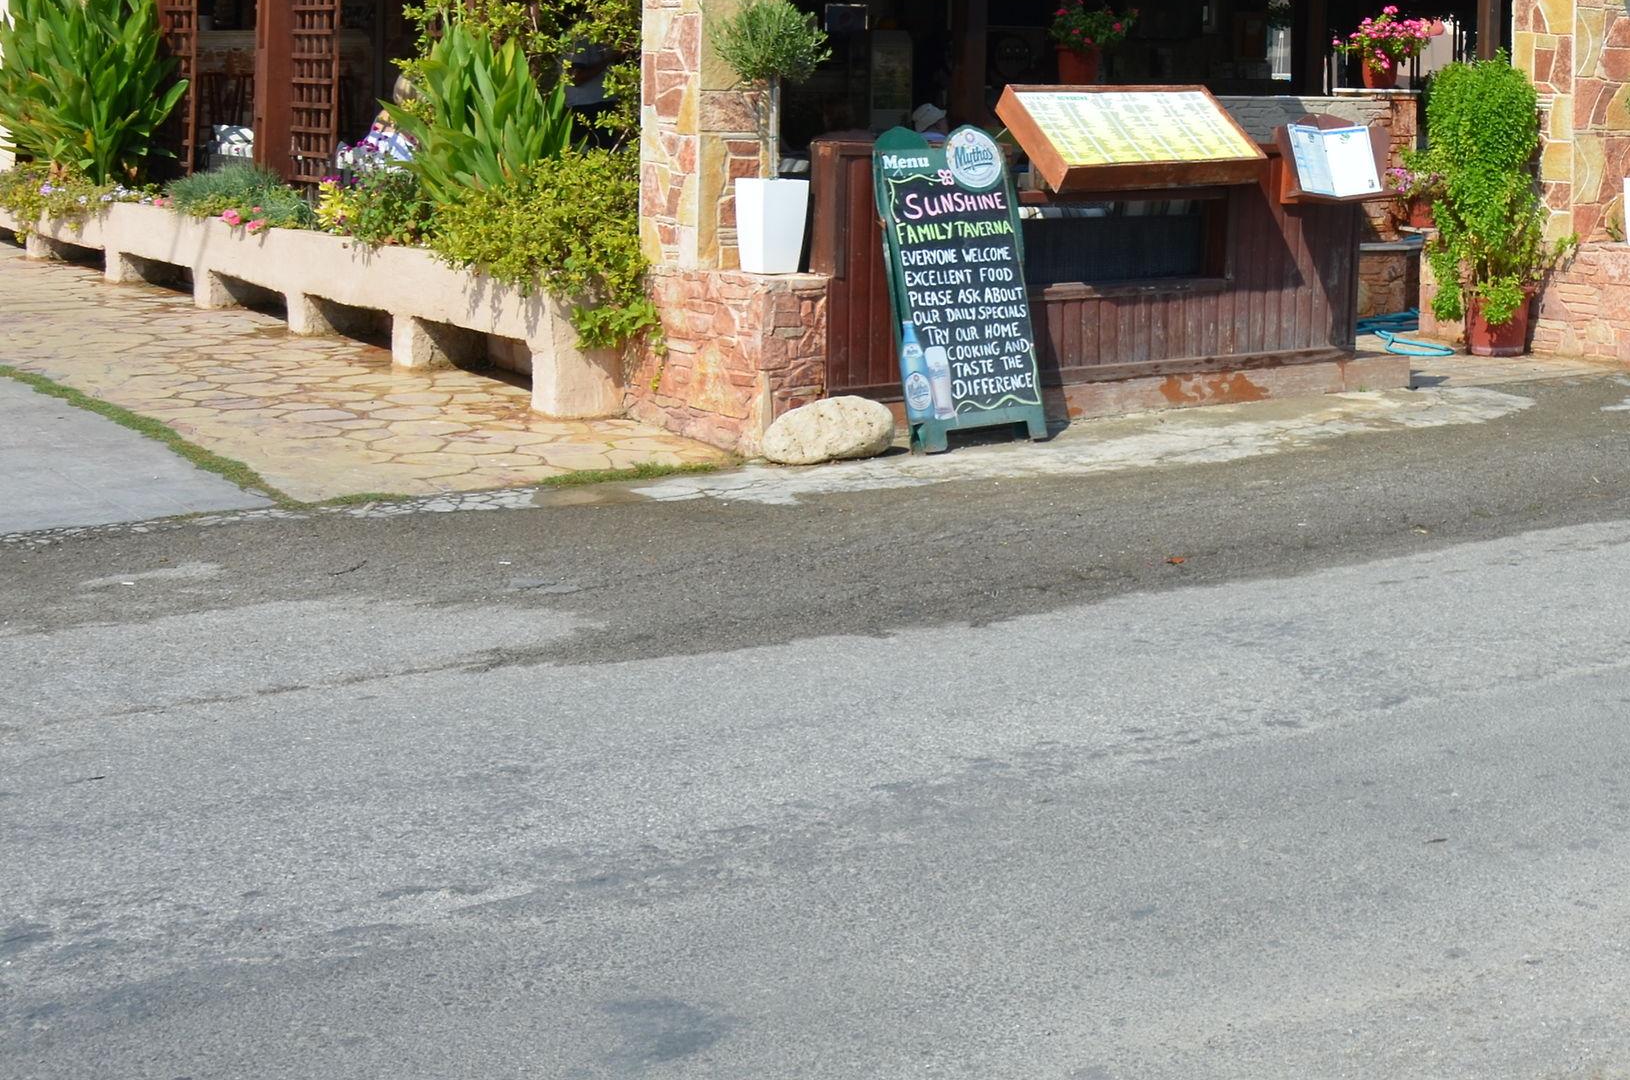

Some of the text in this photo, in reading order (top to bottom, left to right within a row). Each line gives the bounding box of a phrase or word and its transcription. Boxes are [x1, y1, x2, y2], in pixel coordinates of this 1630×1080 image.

[882, 154, 930, 170] Menu
[955, 146, 993, 170] Mythos
[903, 191, 1007, 220] SUNSHINE
[895, 219, 1013, 245] FAMILY TAVERNA
[901, 246, 1012, 267] EVERYONE WELCOME
[904, 267, 1013, 287] EXCELLENT FOOD
[908, 287, 1023, 307] PLEASE ASK ABOUT
[913, 304, 1027, 326] OUR DAILY SPECIALS
[922, 322, 1021, 346] TRY OUR HOME
[947, 340, 1030, 361] COOKING AND
[952, 355, 1024, 378] TASTE THE
[952, 372, 1034, 400] DIFFERENCE
